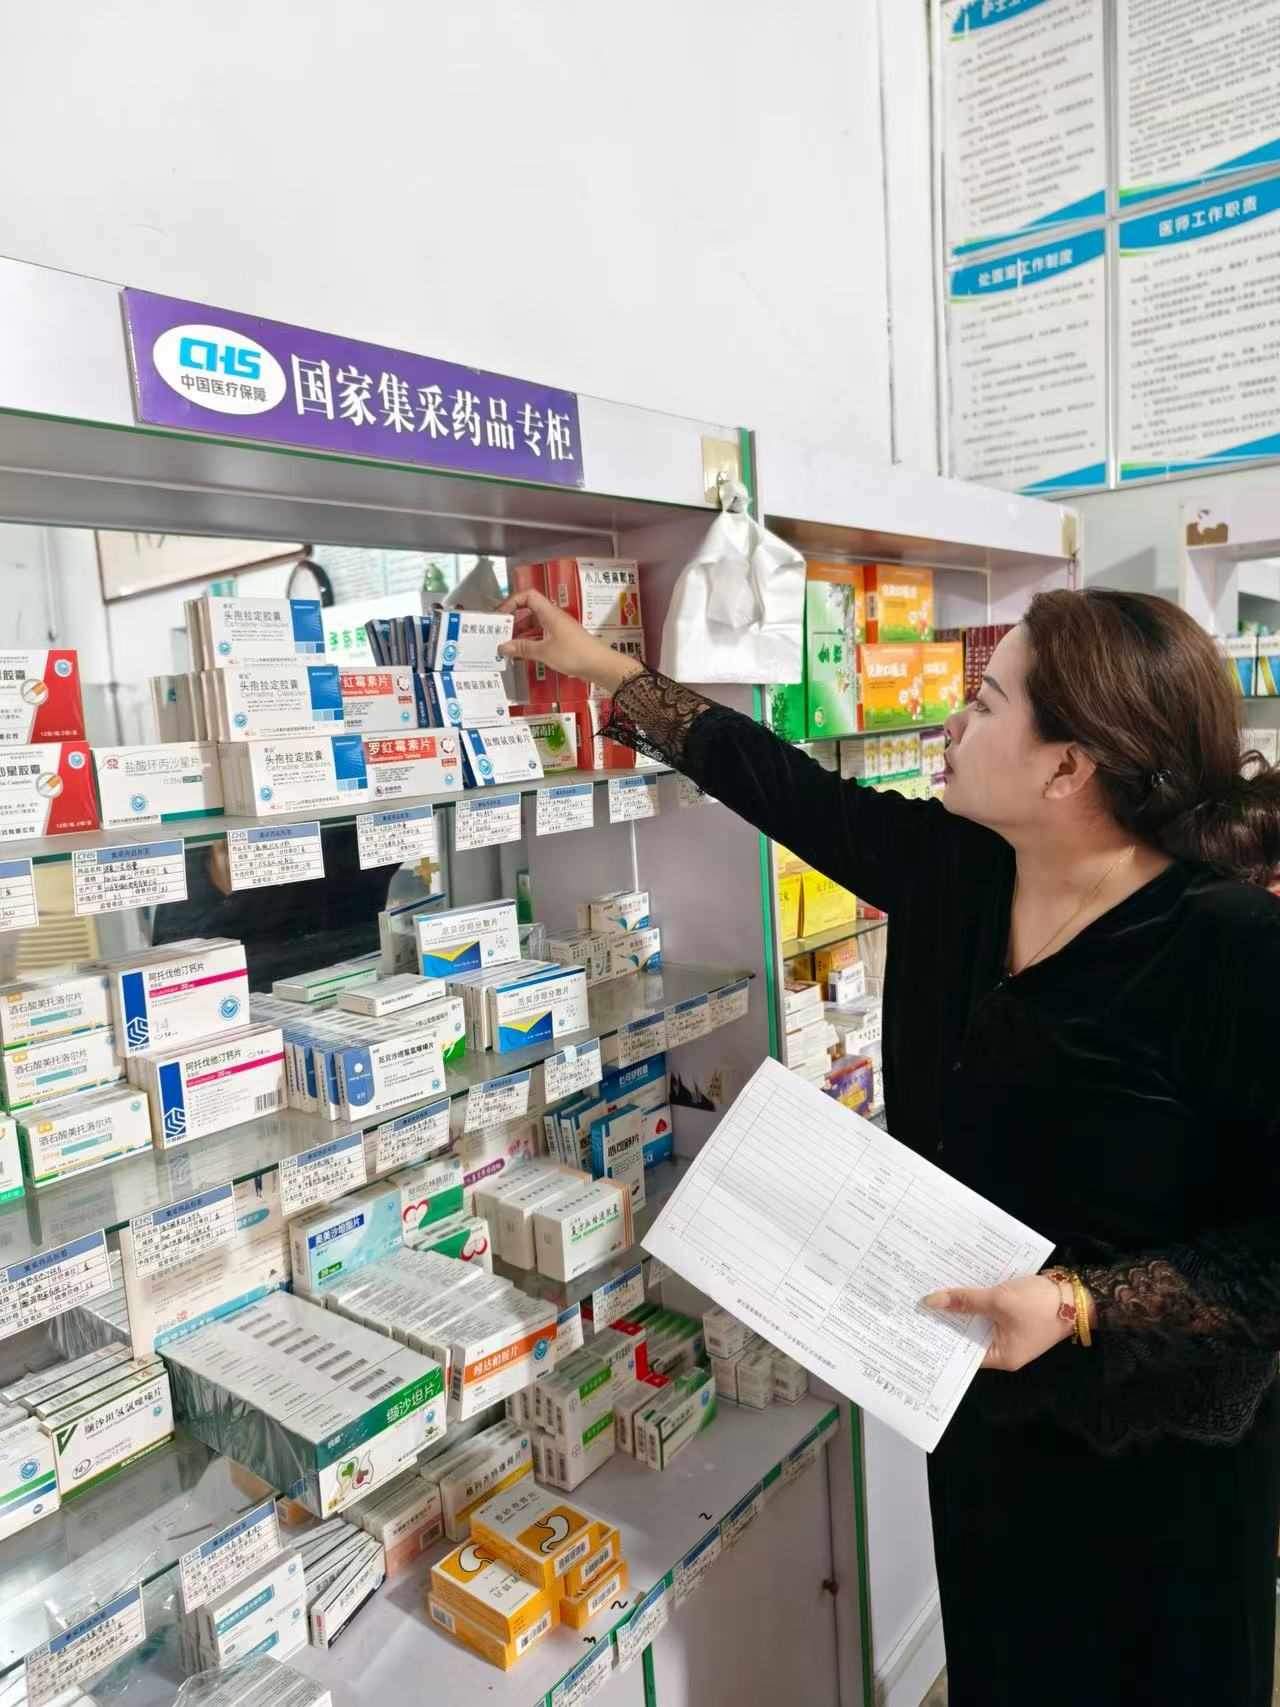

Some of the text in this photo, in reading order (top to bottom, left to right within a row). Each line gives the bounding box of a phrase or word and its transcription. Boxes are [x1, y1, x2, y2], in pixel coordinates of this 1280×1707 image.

[179, 337, 262, 381] CHS
[180, 373, 267, 405] 中国医疗保障
[290, 353, 575, 462] 国家集采药品专柜
[224, 611, 282, 622] 头孢拉定胶囊
[0, 669, 26, 681] 胶囊
[240, 680, 299, 691] 头孢拉定胶囊
[342, 674, 388, 688] 红霉素片
[264, 750, 323, 764] 头孢拉定胶囊
[367, 740, 432, 756] 罗红霉素片
[124, 757, 201, 773] 盐酸环丙沙星片
[442, 917, 499, 936] 厄贝沙坦分散片
[149, 963, 205, 982] 阿托伐他汀钙片
[8, 992, 83, 1016] 酒石酸美托洛尔片
[518, 987, 569, 1006] 厄贝沙坦分散片
[13, 1049, 88, 1076] 酒石酸美托洛尔片
[186, 1049, 242, 1072] 阿托伐他汀钙片
[378, 1042, 435, 1064] 厄贝沙坦氢氯噻嗪片
[38, 1117, 113, 1147] 酒石酸美托洛尔片
[315, 1215, 362, 1246] 奥美沙坦酯片
[84, 1387, 162, 1436] 缬沙坦氢氯噻嗪片
[386, 1383, 436, 1424] 缬沙坦片
[465, 1450, 522, 1498] 格列齐特缓释片
